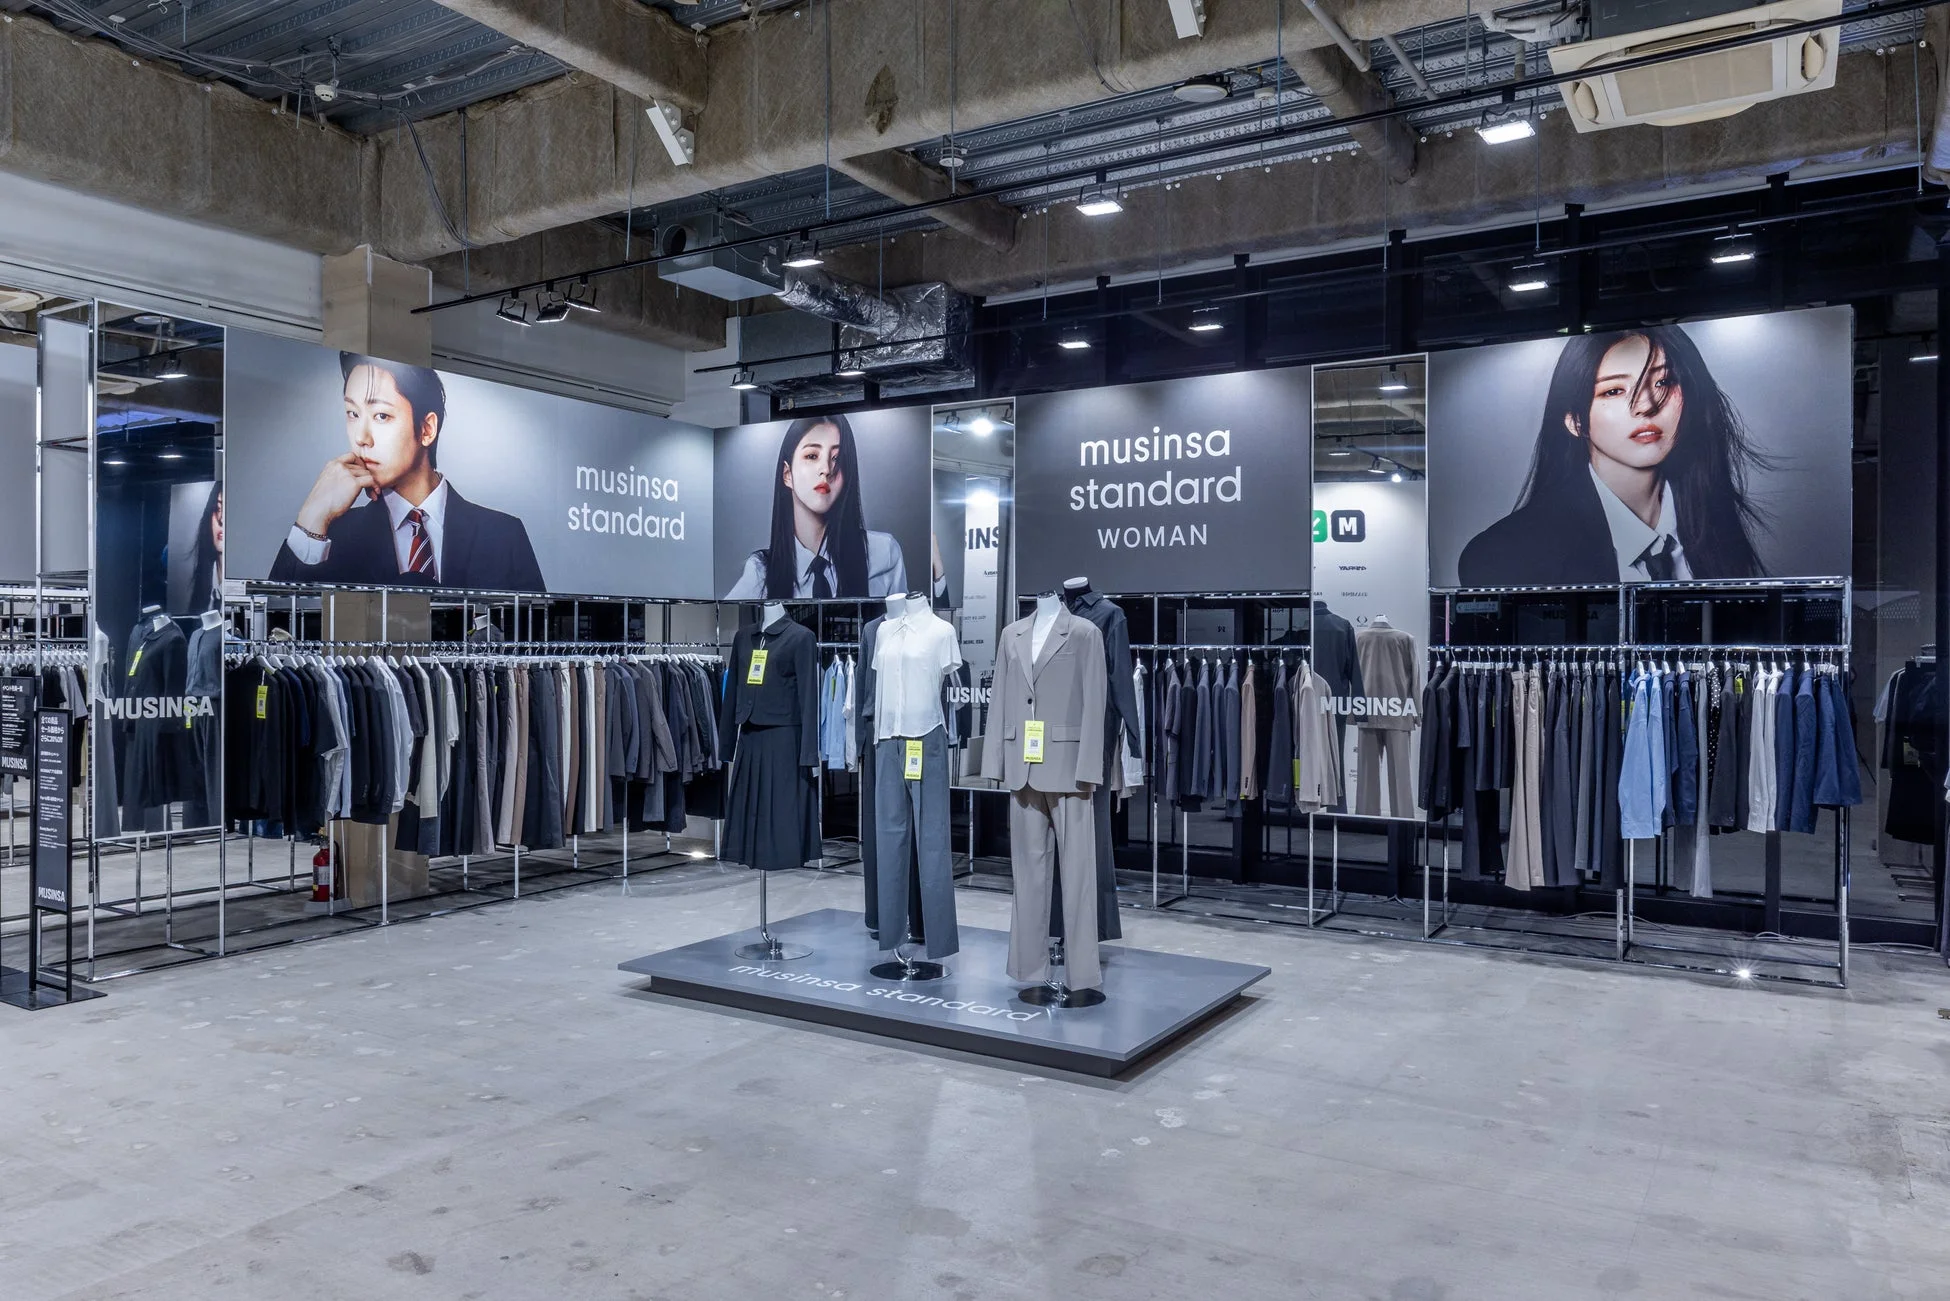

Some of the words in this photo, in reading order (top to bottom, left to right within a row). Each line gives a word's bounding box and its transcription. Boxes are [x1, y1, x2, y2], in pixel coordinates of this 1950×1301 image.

[1080, 426, 1231, 467] musinsa
[576, 465, 679, 503] musinsa
[1070, 465, 1242, 511] standard
[567, 502, 685, 541] standard
[1097, 523, 1208, 549] WOMAN
[104, 695, 215, 720] MUSINSA
[1320, 696, 1418, 717] MUSINSA
[1, 756, 28, 770] MUSINSA
[38, 886, 66, 903] MUSINSA
[728, 963, 862, 992] musinsa
[865, 986, 1041, 1022] standard
